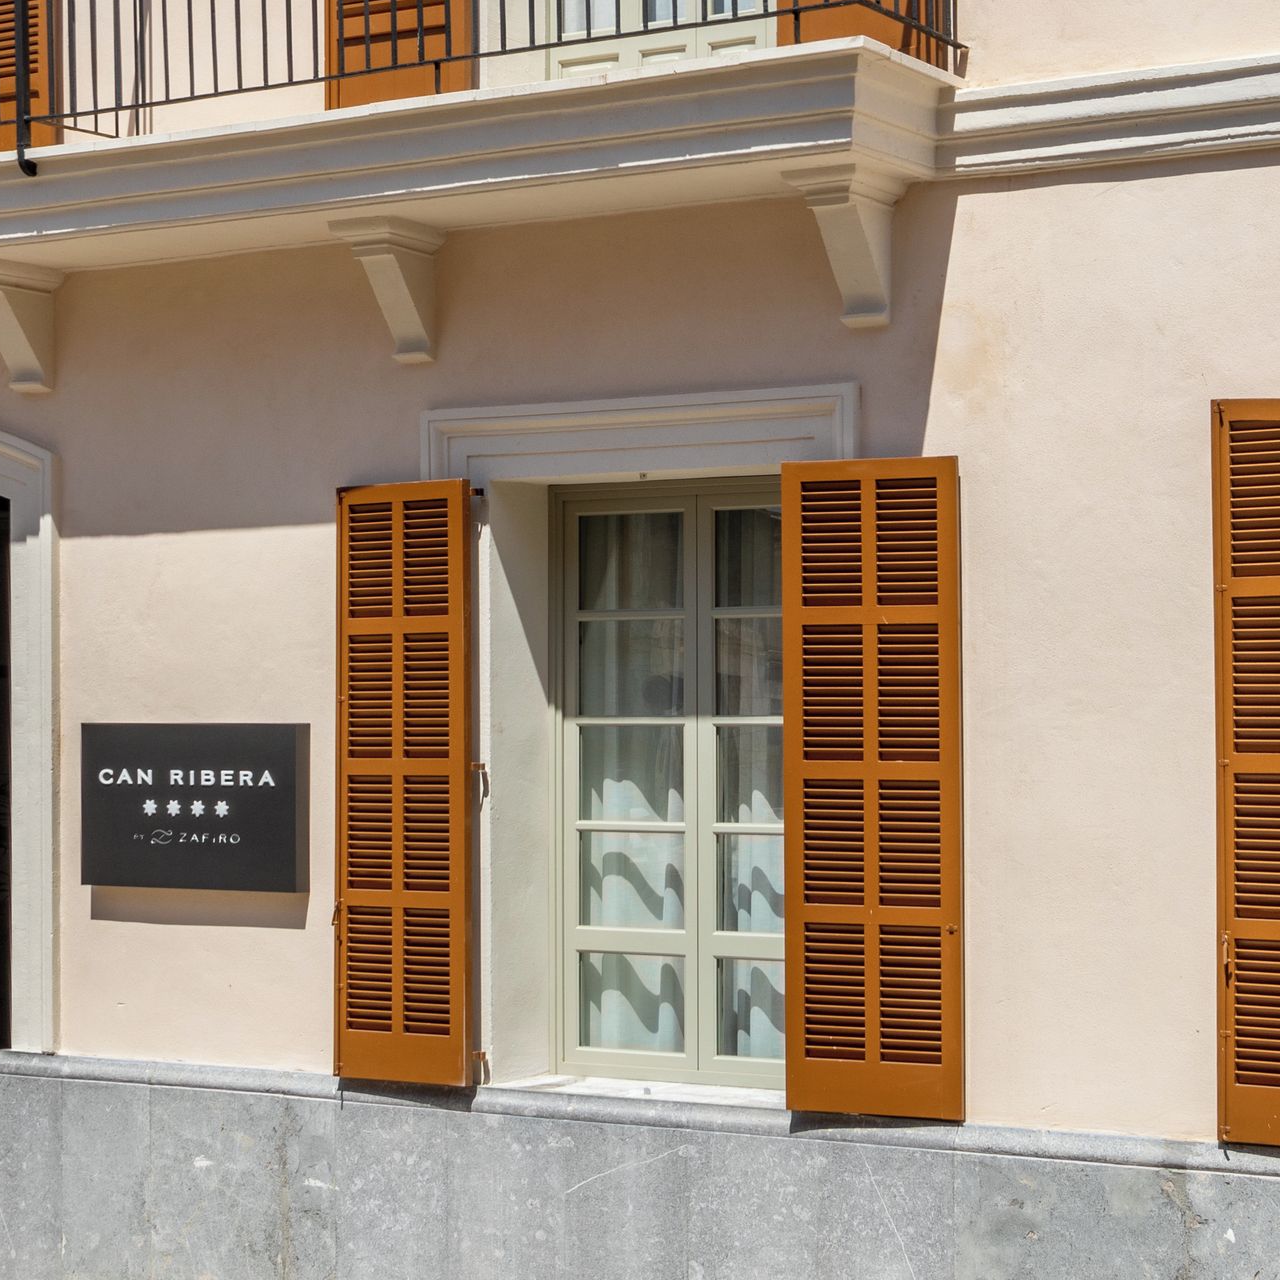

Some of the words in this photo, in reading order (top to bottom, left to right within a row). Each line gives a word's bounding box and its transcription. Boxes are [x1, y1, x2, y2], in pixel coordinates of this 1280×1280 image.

[98, 767, 153, 786] CAN
[169, 769, 276, 787] RIBERA
[178, 832, 241, 845] ZAFIRO
